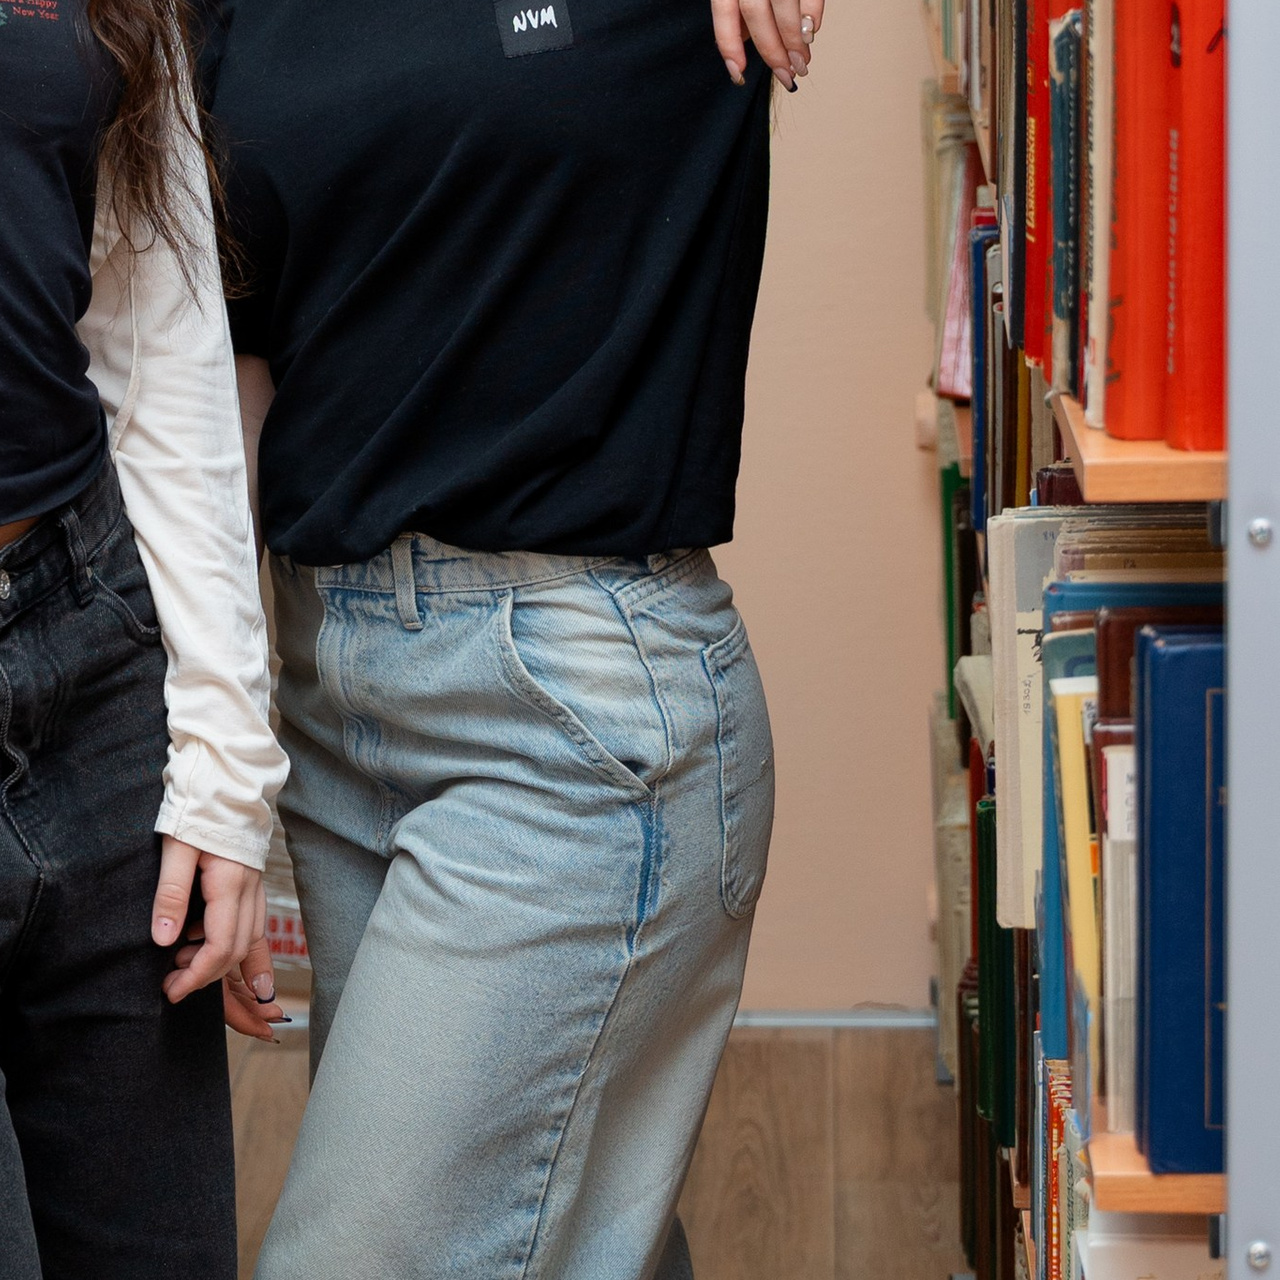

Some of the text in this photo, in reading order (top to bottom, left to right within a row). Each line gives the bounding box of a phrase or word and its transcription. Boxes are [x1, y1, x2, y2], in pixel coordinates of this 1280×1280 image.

[12, 6, 60, 21] New Year
[512, 5, 558, 33] NVM
